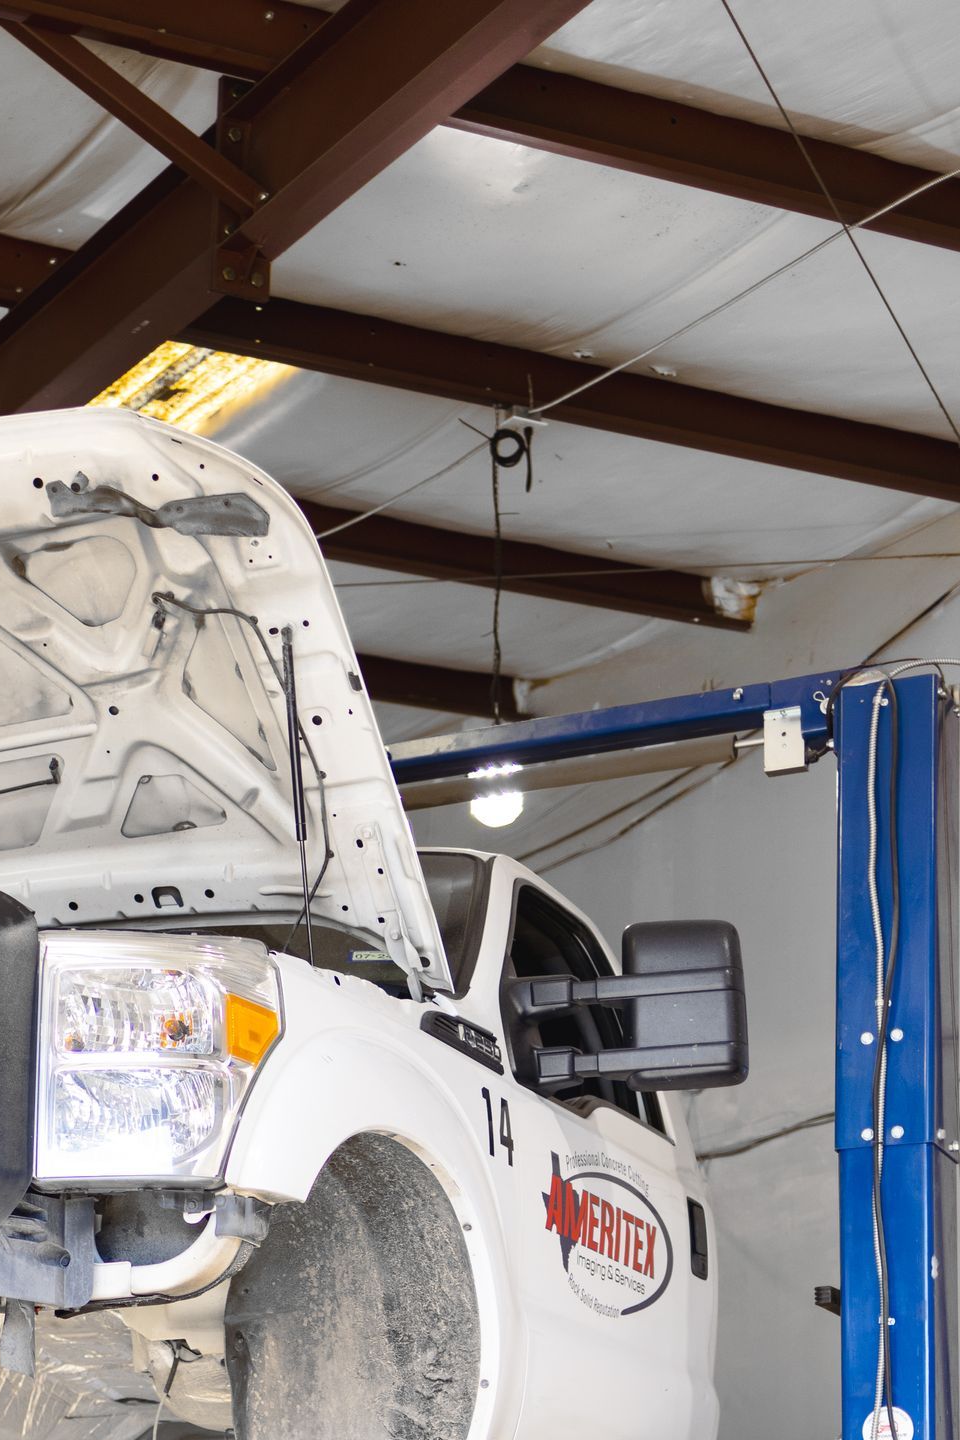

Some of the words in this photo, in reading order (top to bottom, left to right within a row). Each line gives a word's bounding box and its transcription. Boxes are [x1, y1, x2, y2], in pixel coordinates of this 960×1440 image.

[481, 1086, 514, 1167] 14
[565, 1150, 600, 1171] Professional
[601, 1152, 628, 1177] Concrete
[545, 1173, 657, 1280] AMERITEX
[576, 1250, 606, 1281] Imaging
[607, 1264, 614, 1281] &
[614, 1268, 646, 1295] Services
